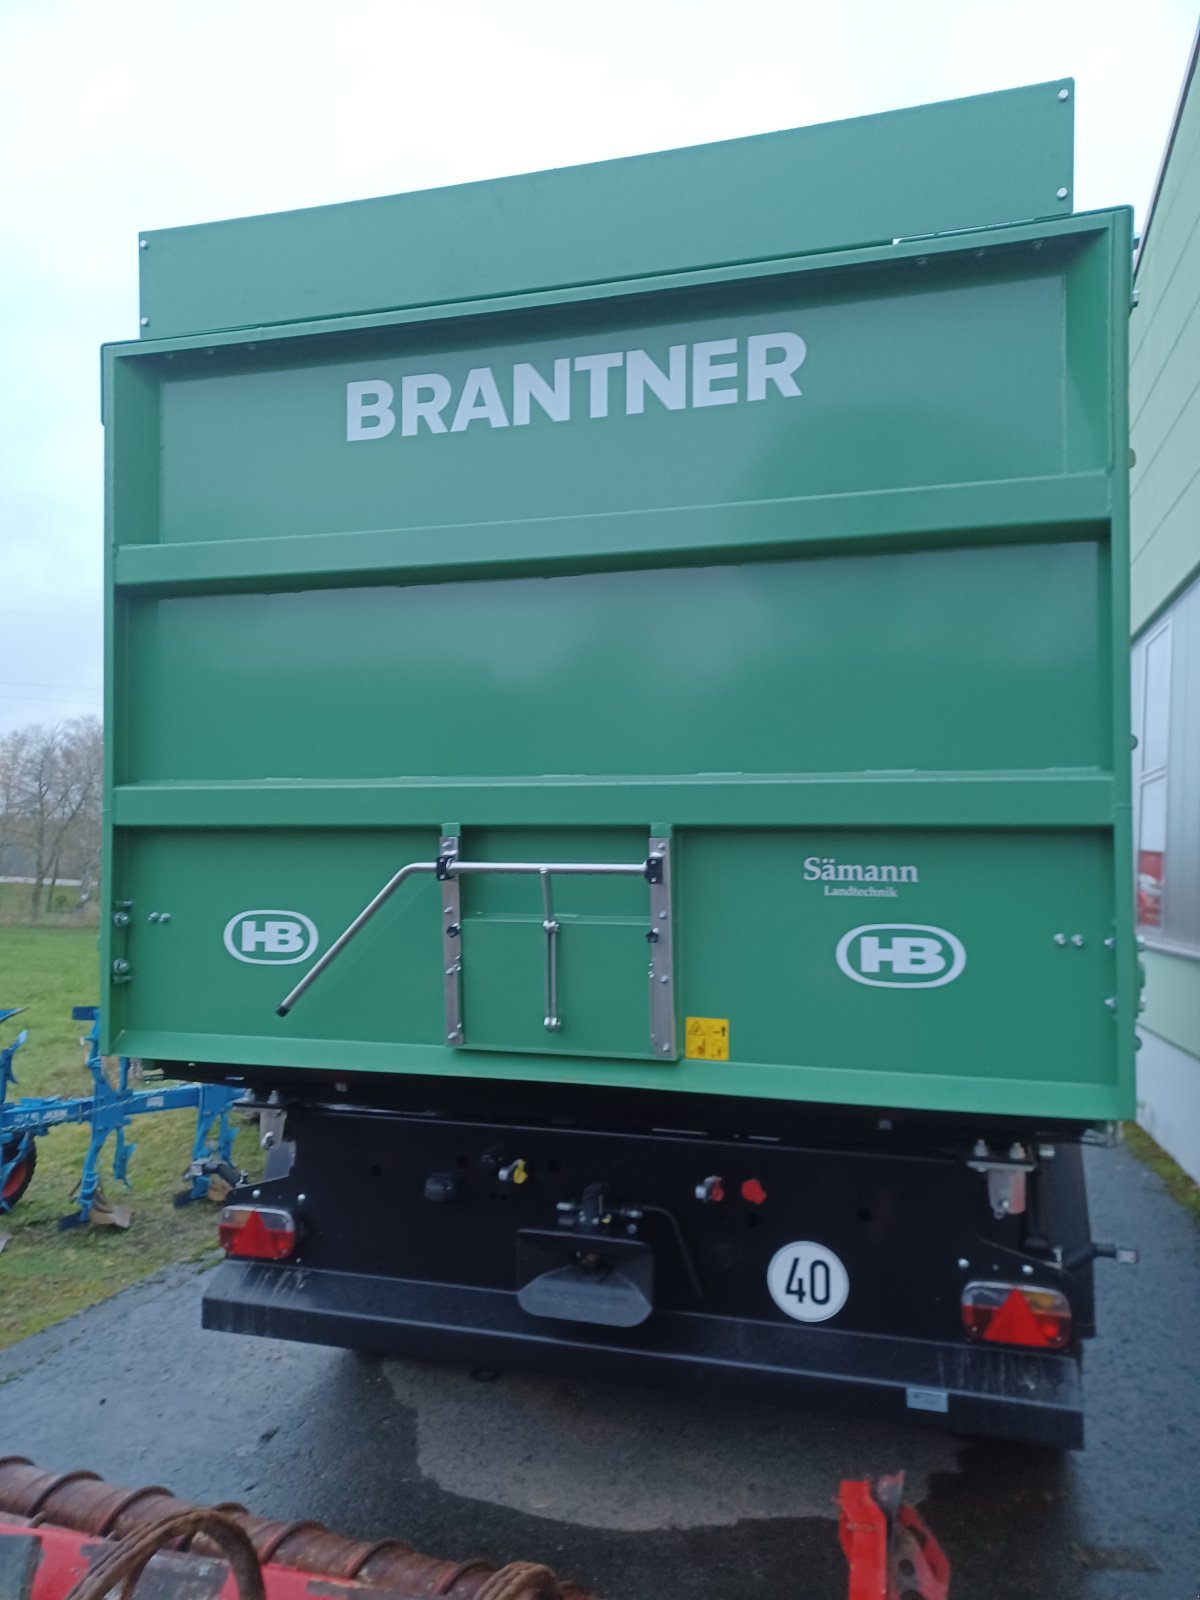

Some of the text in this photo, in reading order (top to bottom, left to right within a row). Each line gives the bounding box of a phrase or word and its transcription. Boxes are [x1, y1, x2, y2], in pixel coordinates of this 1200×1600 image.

[346, 331, 808, 442] BRANTNER
[803, 856, 920, 883] Sämann
[824, 885, 898, 898] Landtechnik
[241, 920, 305, 953] HB
[860, 936, 947, 975] HB
[785, 1257, 831, 1306] 40
